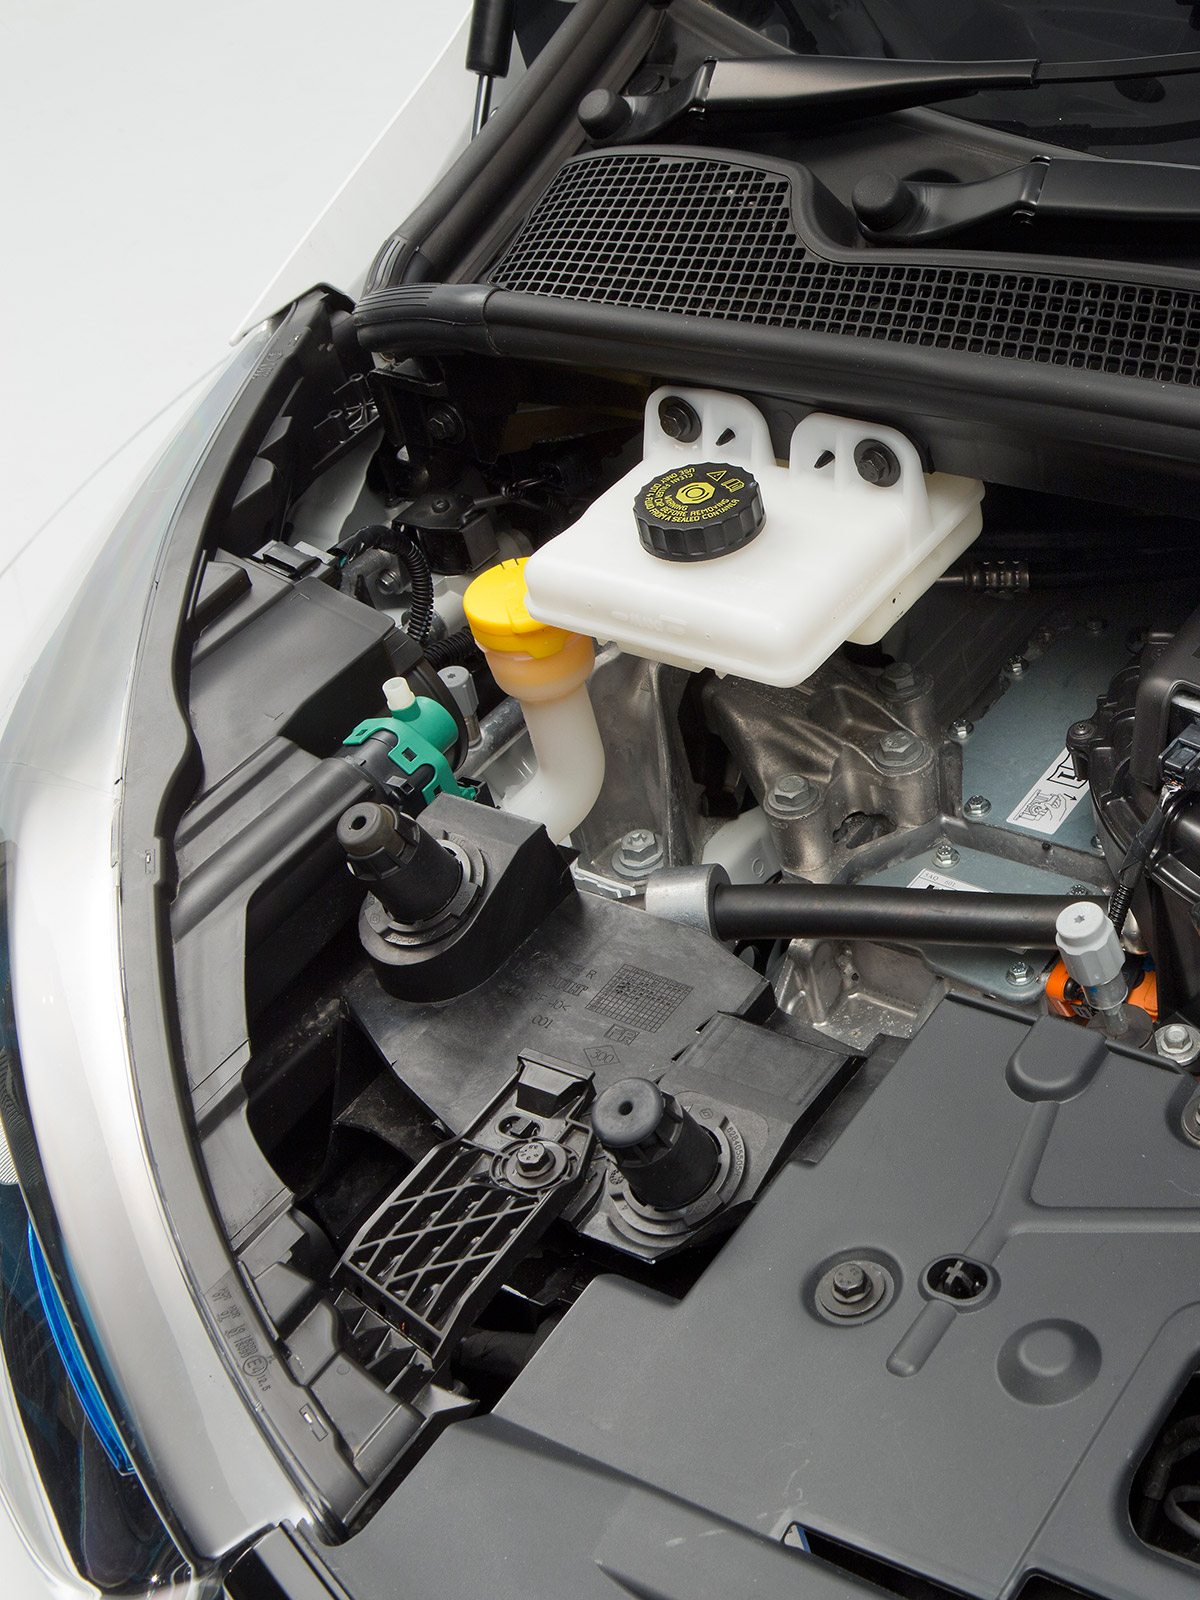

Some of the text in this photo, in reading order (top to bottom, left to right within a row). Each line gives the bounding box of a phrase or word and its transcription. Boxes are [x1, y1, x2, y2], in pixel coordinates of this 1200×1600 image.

[678, 467, 695, 475] USE
[660, 472, 678, 484] ONLY
[670, 472, 694, 484] CLEAN
[649, 483, 662, 493] DOT
[664, 494, 689, 511] WARNING
[690, 498, 730, 516] REMOVING
[649, 508, 668, 520] FROM
[660, 505, 688, 517] BEFORE
[701, 498, 740, 520] CONTAINER
[590, 1049, 614, 1064] 300
[246, 1360, 265, 1374] E4
